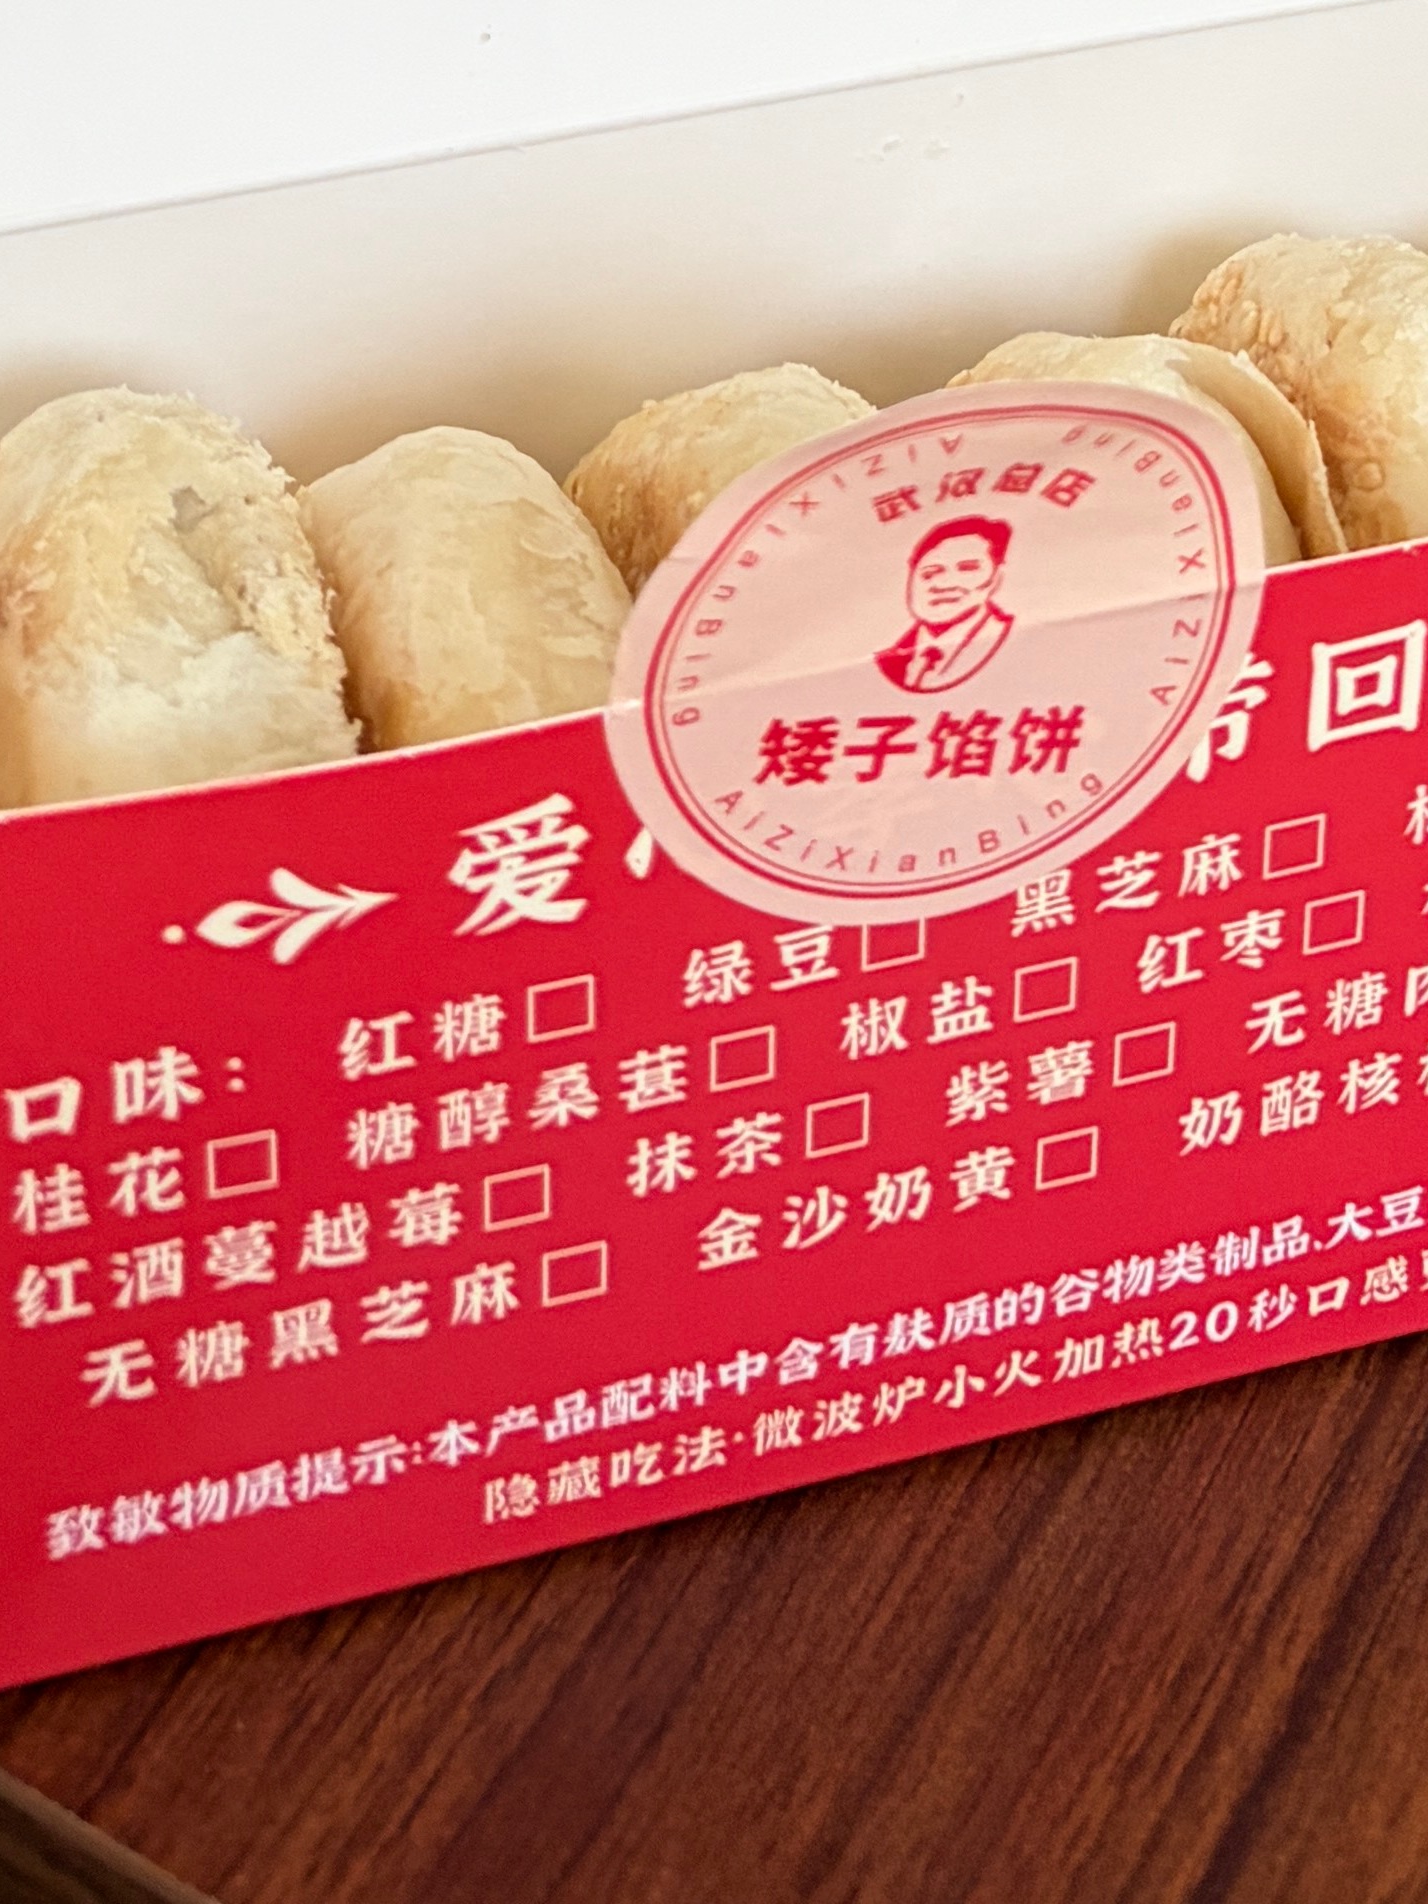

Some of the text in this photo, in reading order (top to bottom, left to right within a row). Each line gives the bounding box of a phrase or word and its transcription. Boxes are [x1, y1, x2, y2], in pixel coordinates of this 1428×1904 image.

[752, 705, 1085, 788] 矮子馅饼
[14, 1147, 183, 1233] 桂花
[348, 1045, 687, 1169] 糖醇桑葚
[841, 976, 992, 1059] 椒盐
[1137, 909, 1285, 993] 红枣
[340, 994, 505, 1079] 红糖
[683, 920, 838, 1007] 绿豆
[1011, 834, 1242, 937] 黑芝麻
[16, 1183, 462, 1327] 红酒蔓越莓
[627, 1112, 782, 1196] 抹茶
[946, 1041, 1093, 1126] 紫薯
[83, 1262, 518, 1403] 无糖黑芝麻
[699, 1147, 1015, 1270] 金沙奶黄
